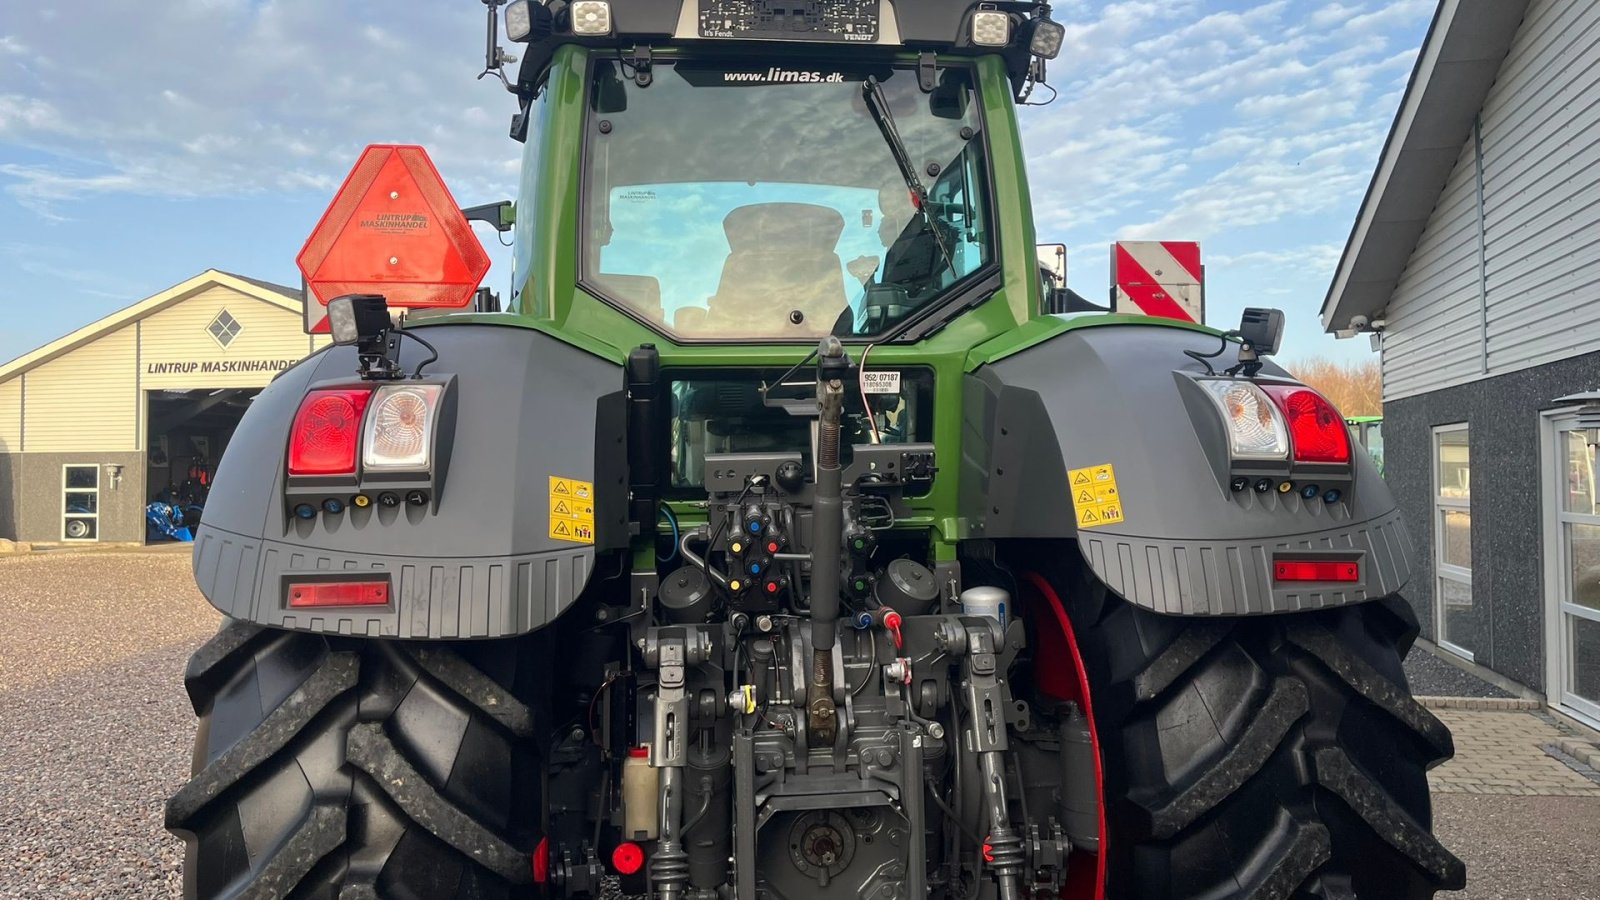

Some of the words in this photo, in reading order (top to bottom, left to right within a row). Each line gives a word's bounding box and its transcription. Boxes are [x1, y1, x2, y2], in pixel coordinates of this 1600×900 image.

[714, 30, 734, 38] Fendt.
[844, 33, 873, 41] FENDT
[723, 67, 844, 83] www.limas.dk
[360, 220, 428, 228] MASKINHANDEL
[148, 362, 198, 374] LINTRUP
[201, 359, 300, 373] MASKINHANDE
